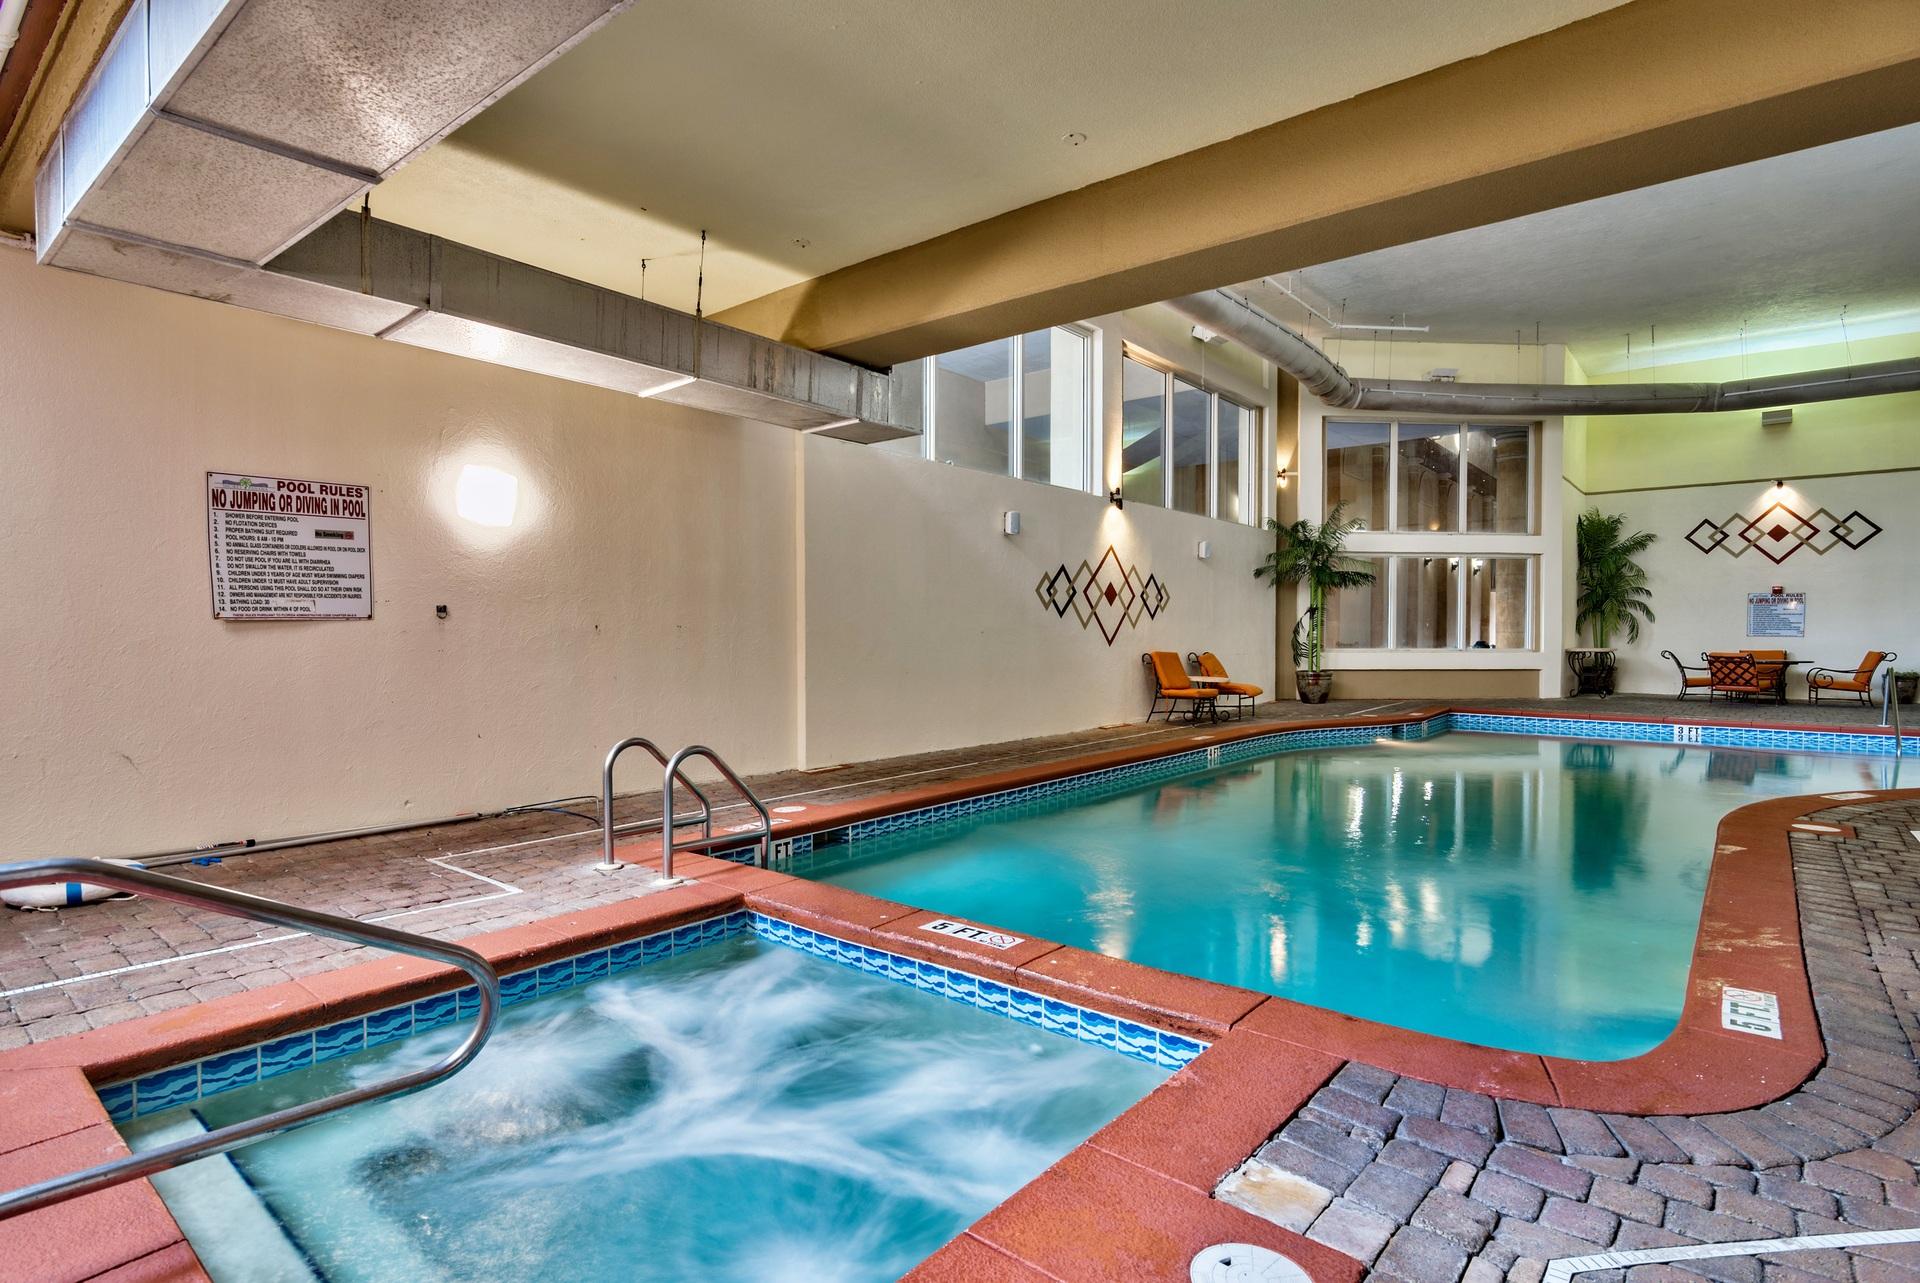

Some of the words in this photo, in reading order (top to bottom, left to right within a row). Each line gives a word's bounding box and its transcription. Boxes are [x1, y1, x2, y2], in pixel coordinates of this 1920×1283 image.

[277, 481, 315, 494] POOL
[320, 485, 363, 498] RULES
[212, 489, 227, 508] NO
[230, 490, 276, 511] JUMPING
[279, 494, 293, 512] OR
[296, 495, 327, 515] DIVING
[331, 498, 339, 516] IN
[343, 499, 366, 517] POOL
[1678, 726, 1684, 734] 3
[1730, 1018, 1772, 1032] 5
